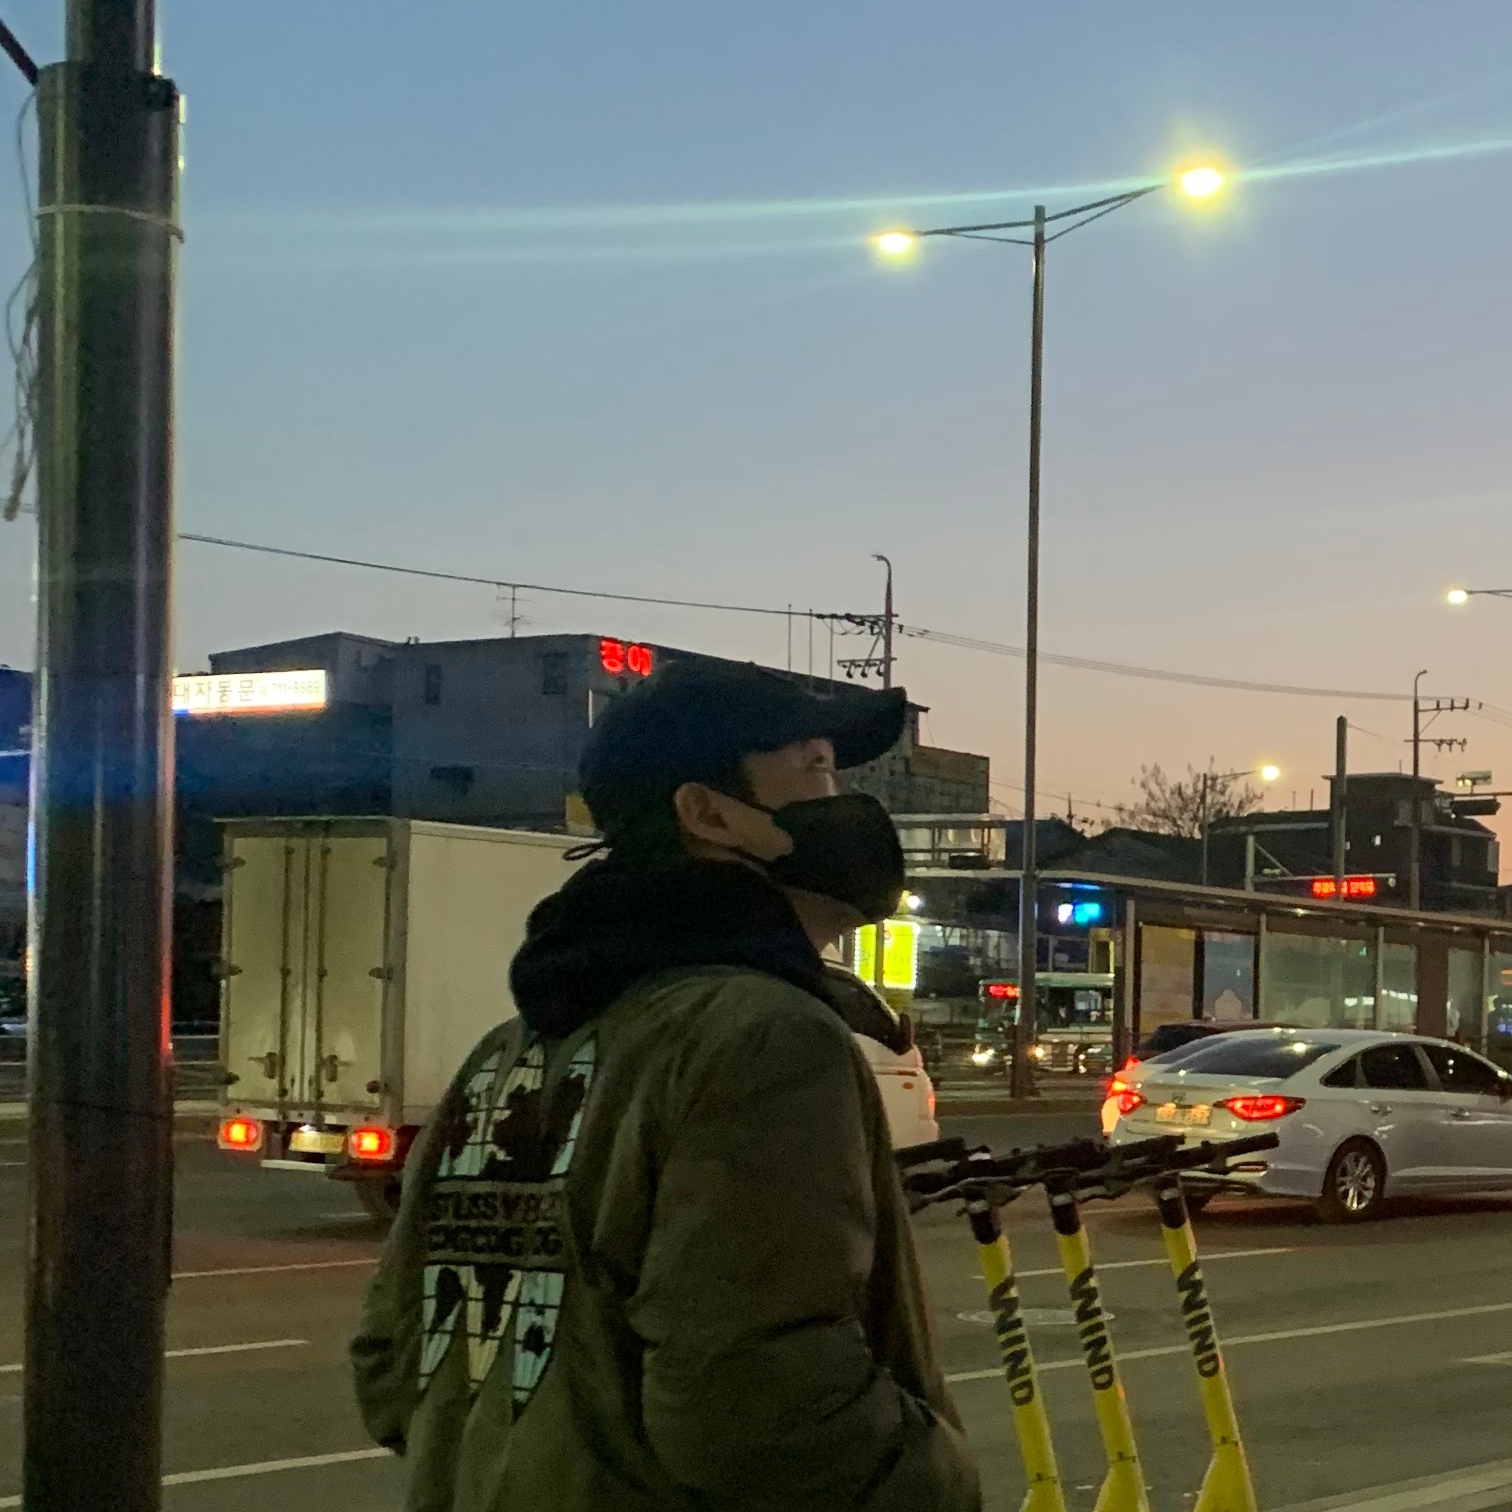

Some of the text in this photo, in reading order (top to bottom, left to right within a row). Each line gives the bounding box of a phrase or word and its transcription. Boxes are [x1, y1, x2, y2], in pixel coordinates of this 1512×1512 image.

[989, 1274, 1034, 1407] WIND
[1070, 1267, 1115, 1391] WIND
[1177, 1261, 1220, 1379] WIND
